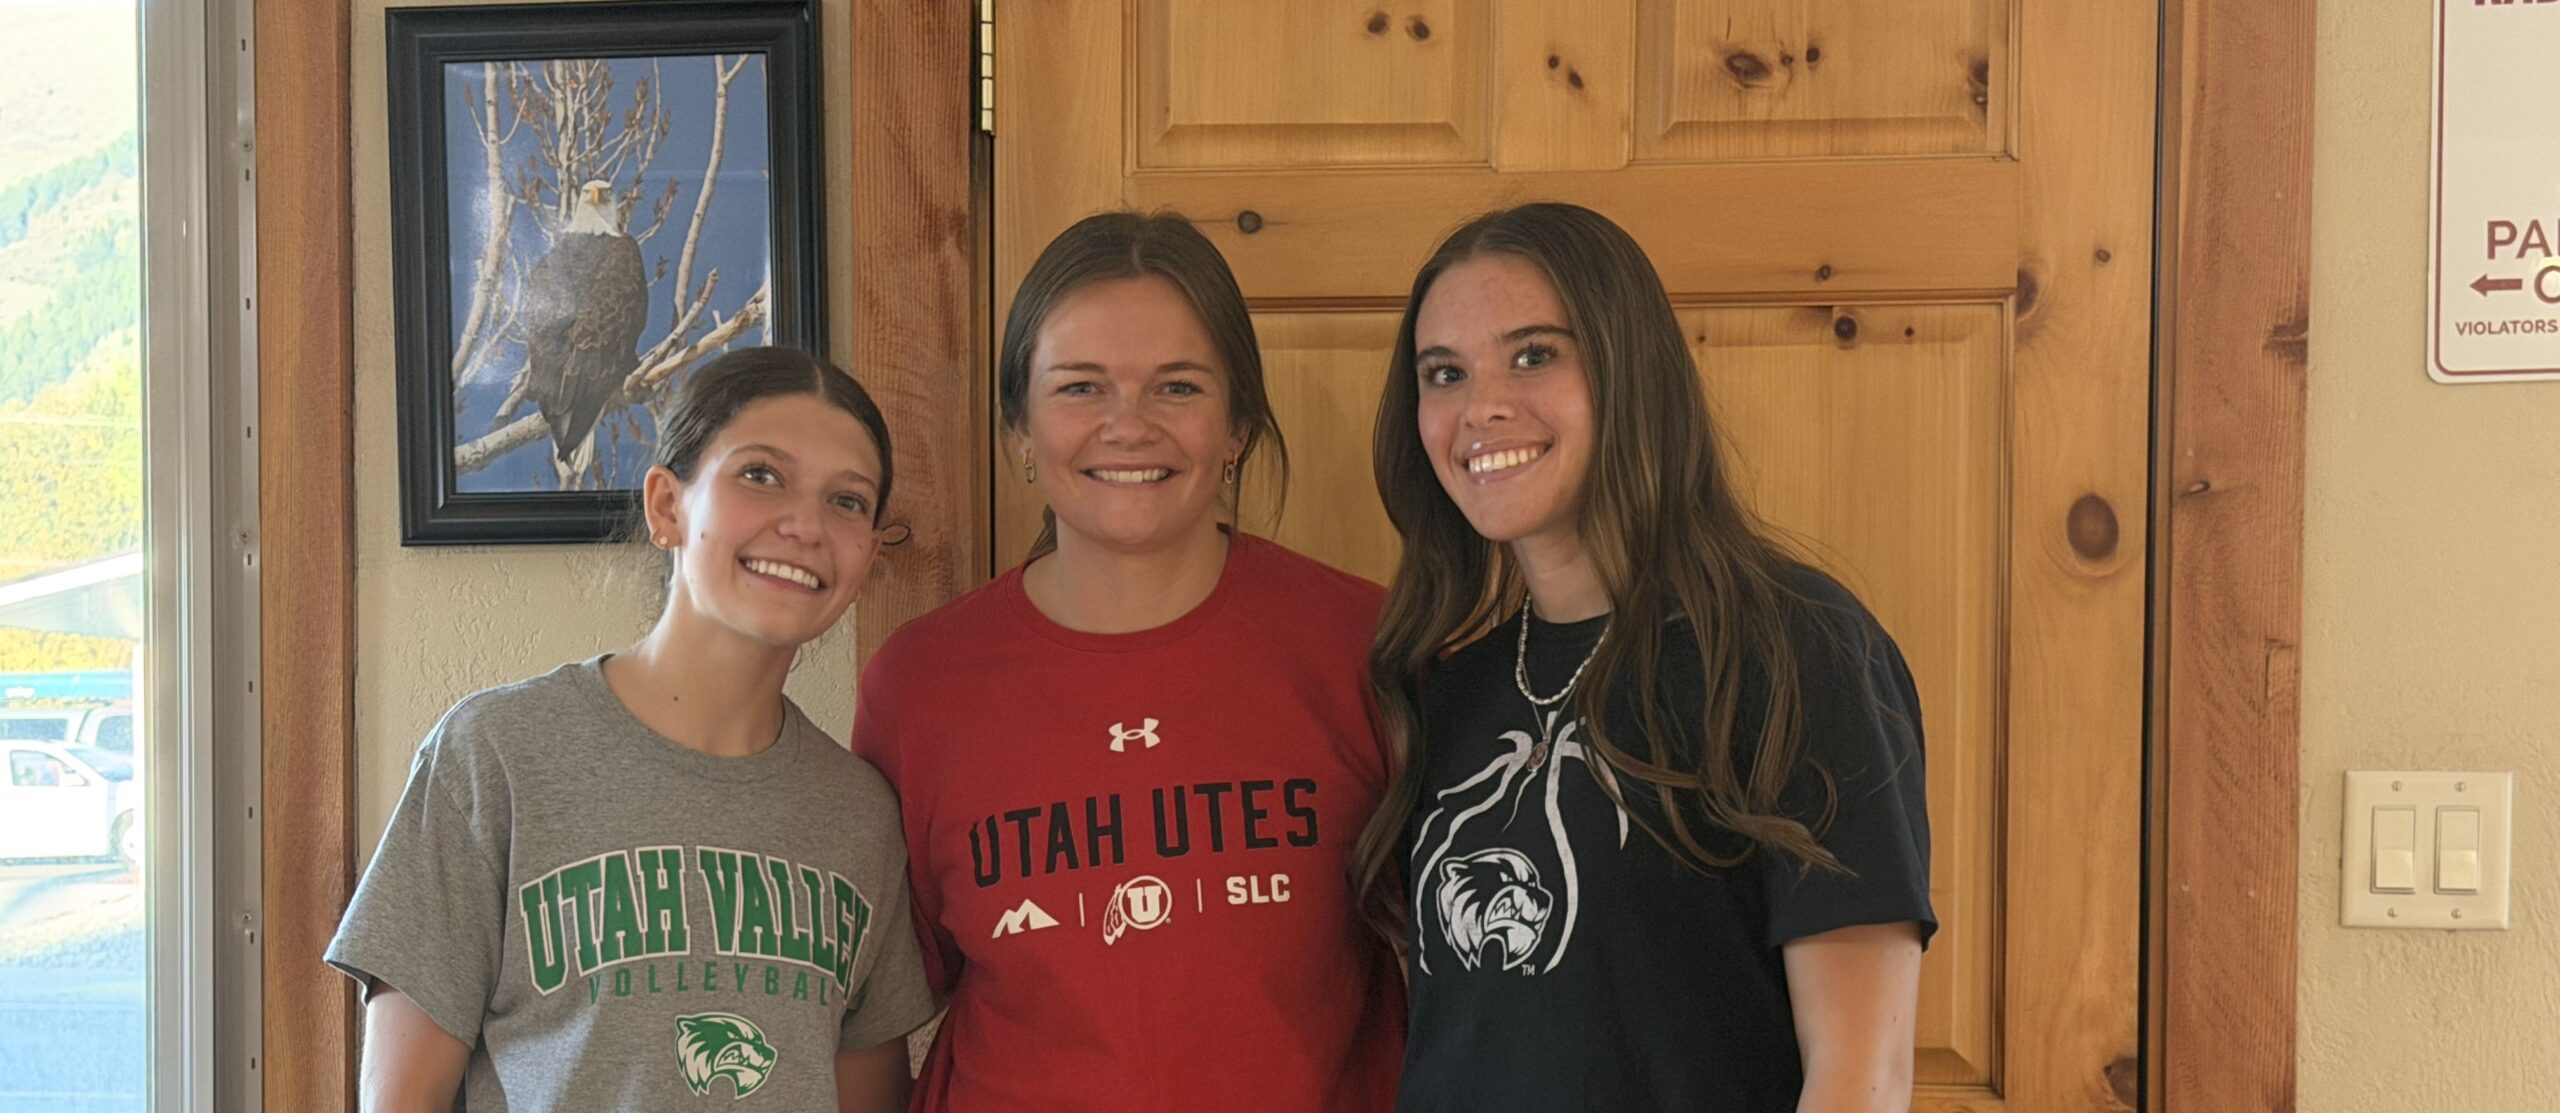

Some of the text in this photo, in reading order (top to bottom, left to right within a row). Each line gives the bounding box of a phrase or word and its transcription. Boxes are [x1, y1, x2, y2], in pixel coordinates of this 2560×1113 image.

[2487, 218, 2560, 260] PA
[2455, 319, 2559, 336] VIOLATORS
[968, 778, 1319, 888] UTAH UTES
[1127, 873, 1291, 923] U SLC
[519, 844, 873, 1005] UTAH VALLEY
[588, 960, 830, 1008] VOLLEYBAL
[1521, 964, 1536, 976] TM
